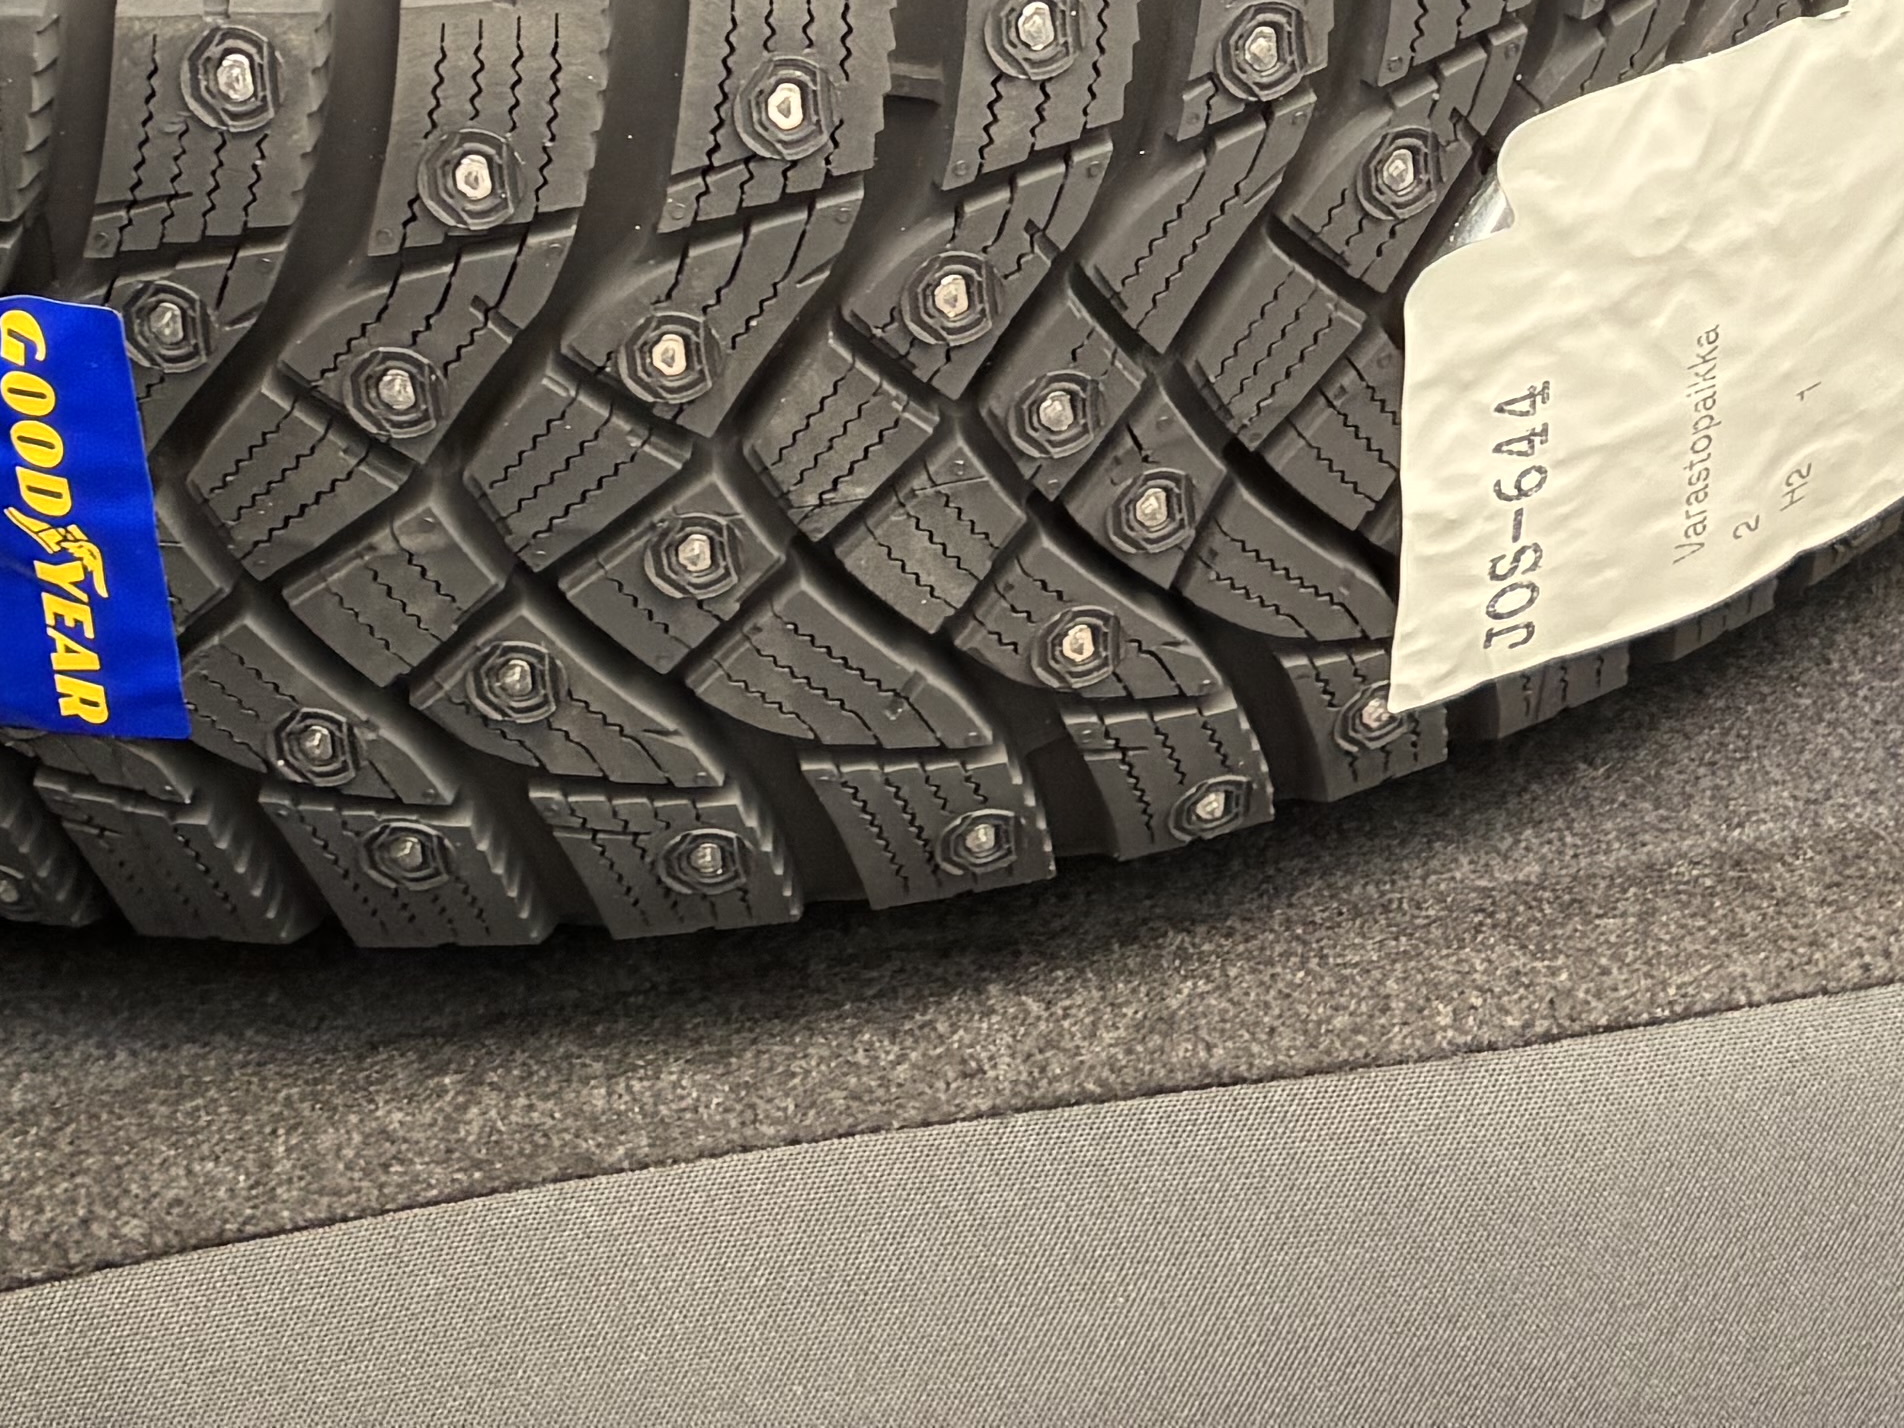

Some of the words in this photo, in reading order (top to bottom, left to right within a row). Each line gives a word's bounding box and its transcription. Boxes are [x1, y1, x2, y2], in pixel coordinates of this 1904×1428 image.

[1483, 380, 1550, 650] JOS-644
[1672, 324, 1722, 564] Varastopaikka
[1780, 462, 1812, 512] H2
[1732, 514, 1760, 540] 2
